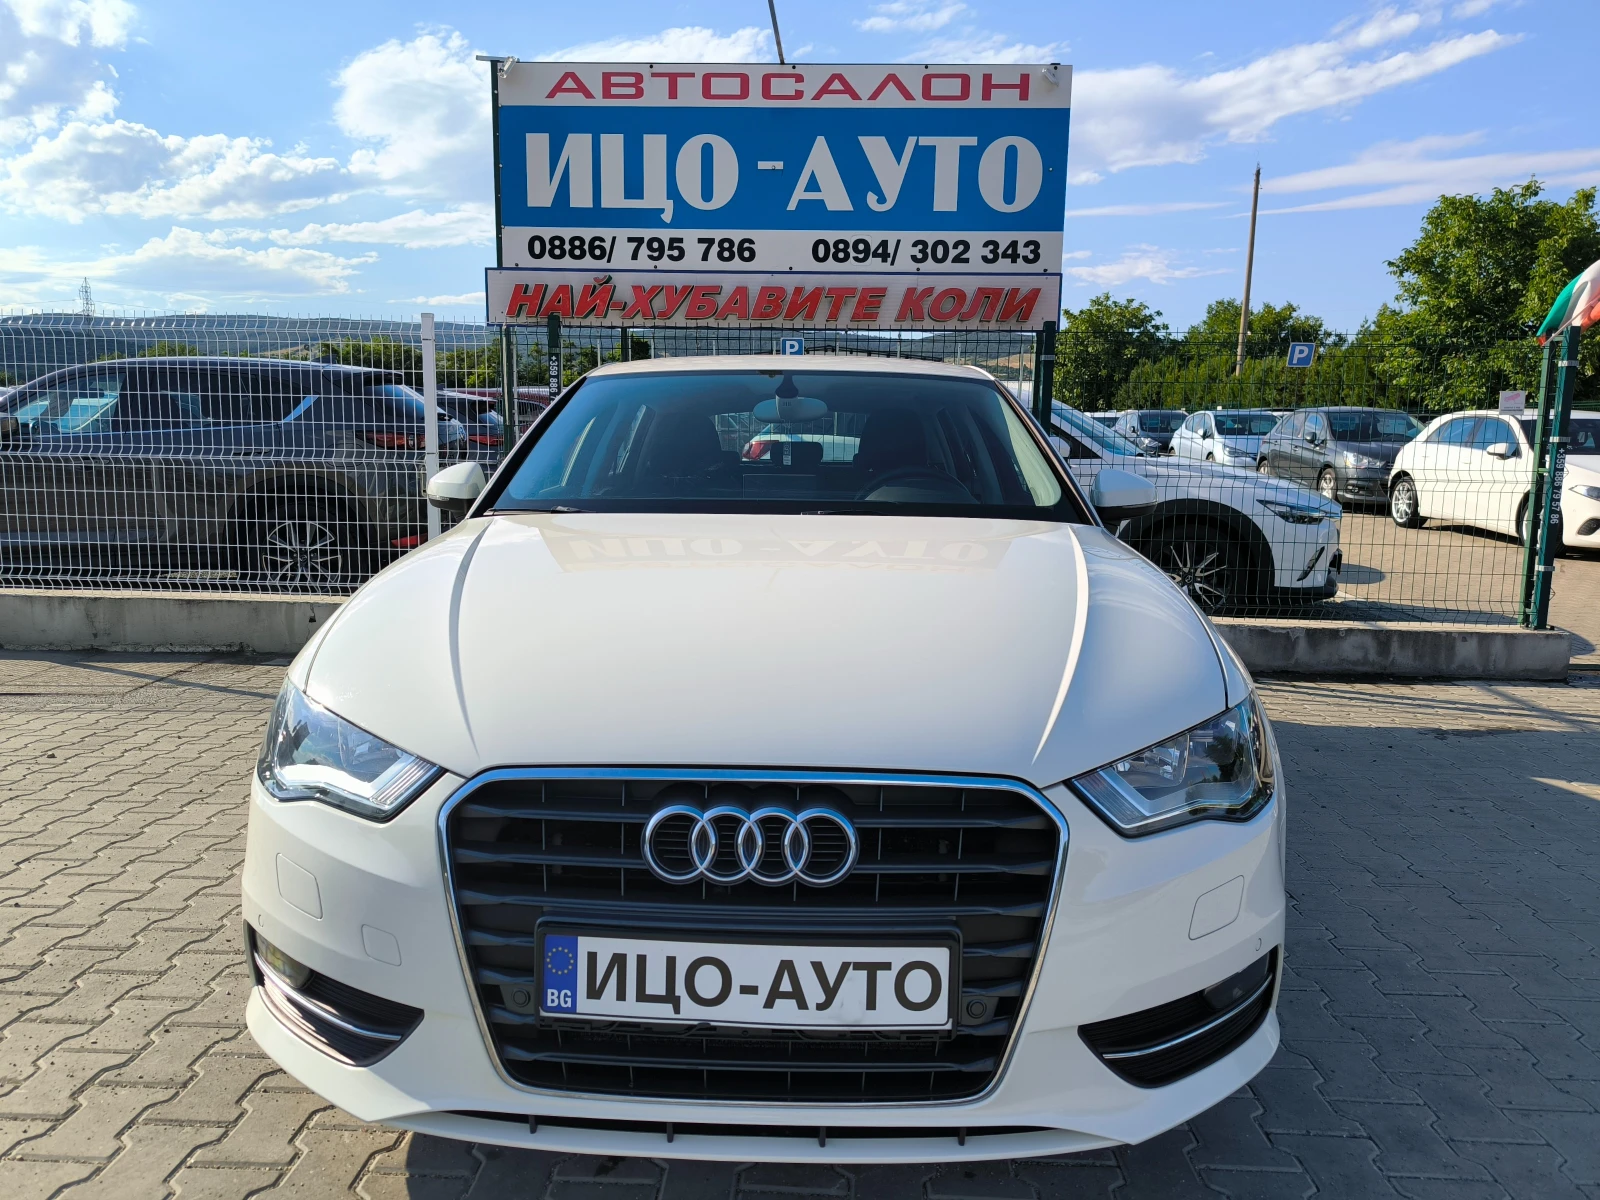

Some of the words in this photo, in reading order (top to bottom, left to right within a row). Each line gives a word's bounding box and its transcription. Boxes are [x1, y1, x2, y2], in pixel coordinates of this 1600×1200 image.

[545, 71, 1031, 101] АВТОСАЛОН
[527, 235, 617, 264] 0886/
[626, 236, 686, 263] 795
[696, 237, 757, 263] 786
[811, 237, 901, 266] 0894/
[910, 239, 971, 264] 302
[980, 240, 1041, 265] 343
[505, 275, 894, 323] НАЙ-ХУБАВИТЕ
[894, 286, 1042, 324] КОЛИ
[785, 340, 799, 355] P
[1292, 345, 1309, 364] P
[550, 355, 558, 375] +359
[550, 378, 558, 392] 886
[1556, 448, 1565, 468] +359
[1554, 471, 1563, 486] 886
[1552, 488, 1561, 499] 79
[1551, 501, 1561, 512] 57
[1550, 513, 1560, 524] 86
[586, 951, 943, 1015] ИЦО-АУТО
[546, 989, 572, 1008] BG
